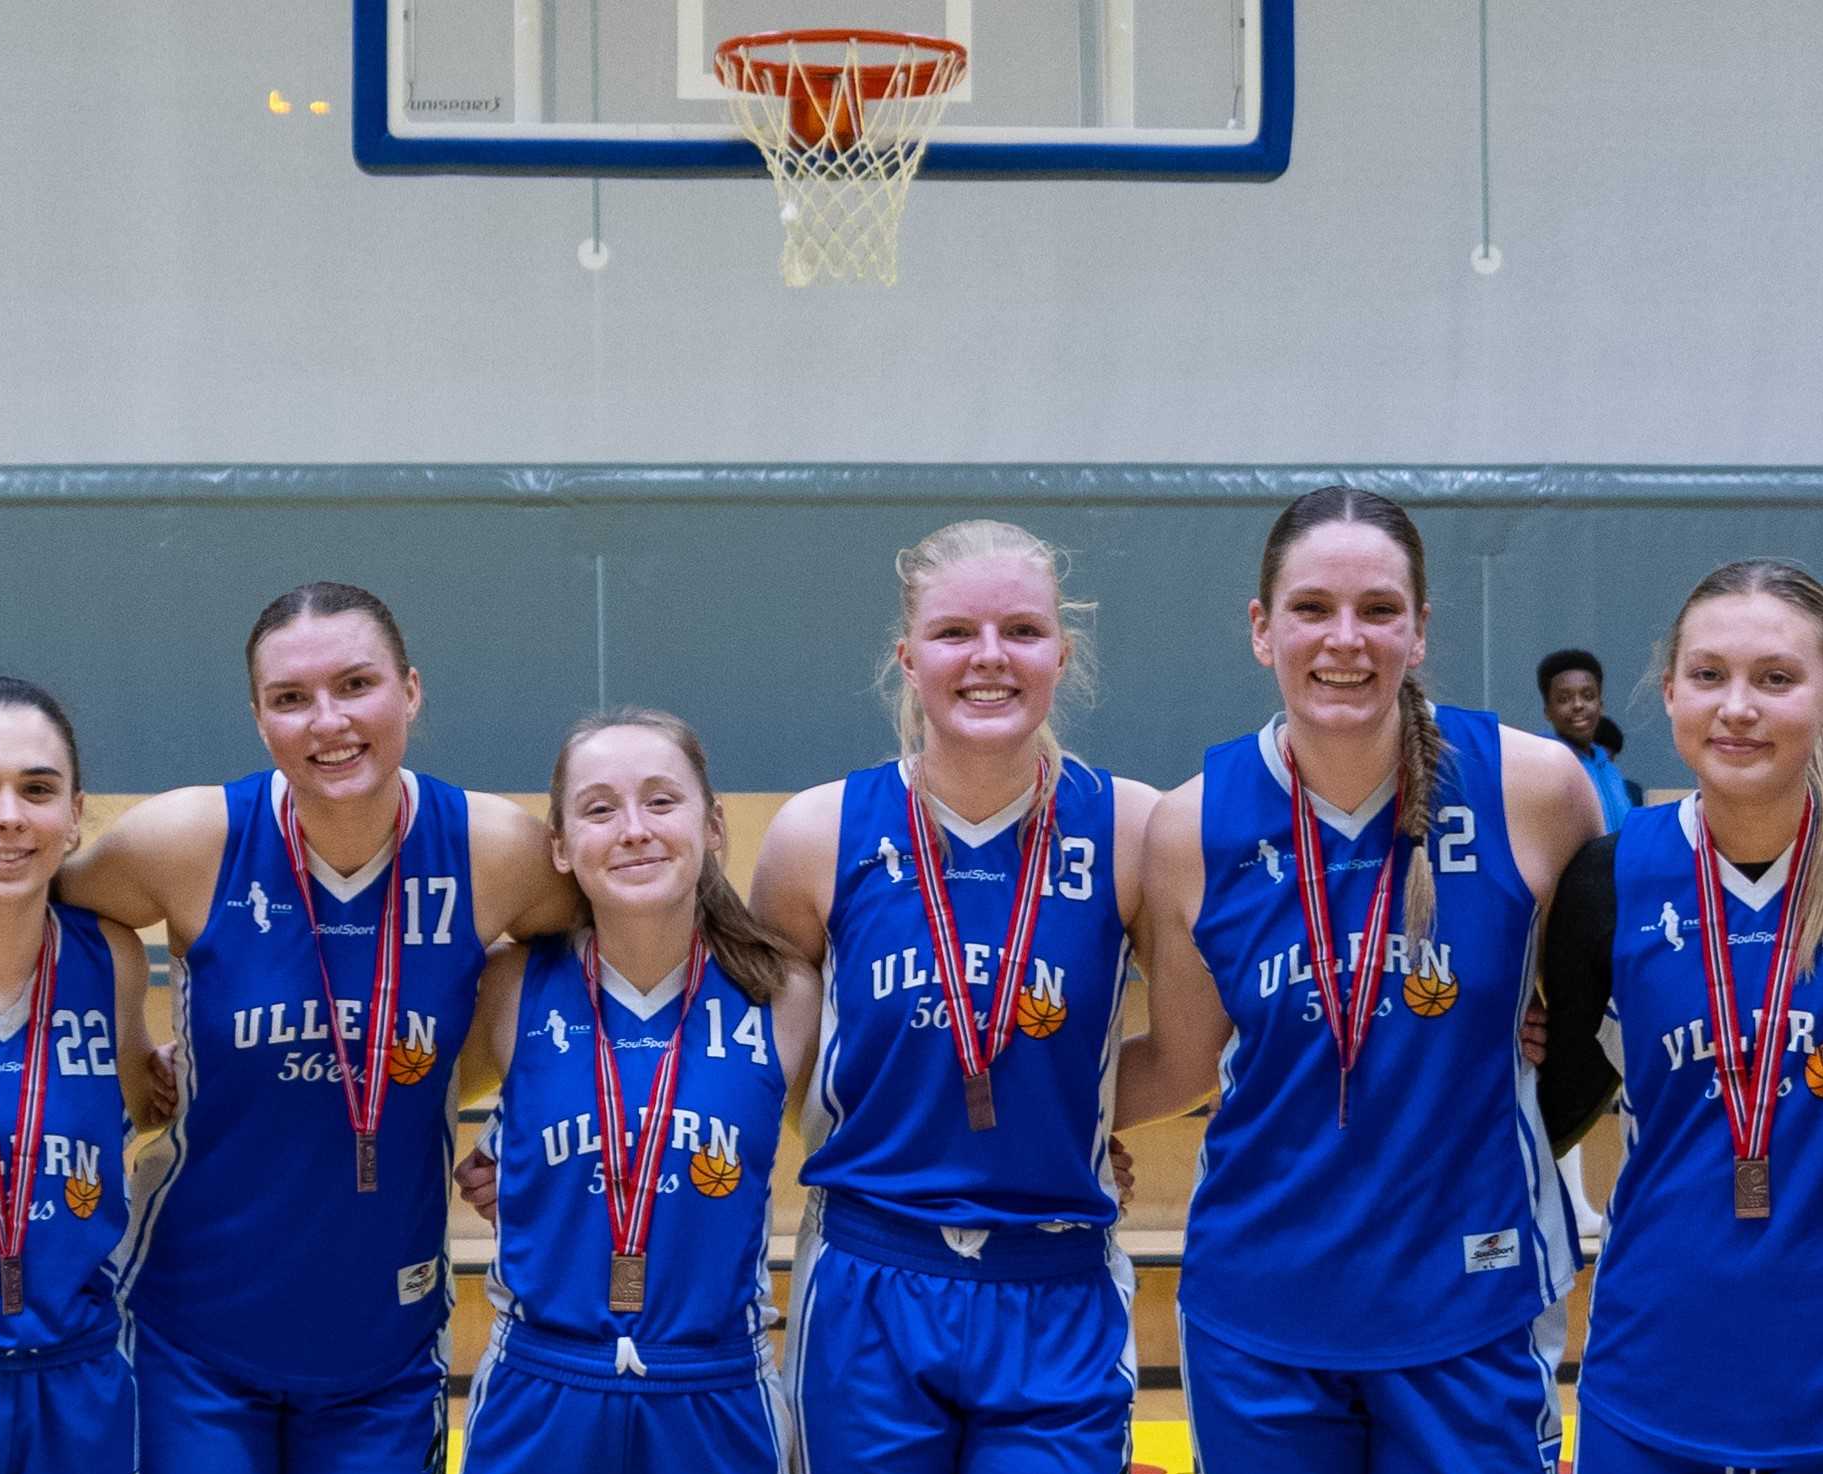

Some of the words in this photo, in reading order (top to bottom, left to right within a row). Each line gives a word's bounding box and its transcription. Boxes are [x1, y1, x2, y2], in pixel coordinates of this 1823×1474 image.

[943, 868, 1008, 882] SoulSport
[1324, 856, 1384, 874] SoulSport
[312, 923, 376, 936] SoulSport
[403, 876, 457, 945] 17
[51, 1009, 118, 1076] 22
[233, 999, 437, 1056] ULLEN
[705, 998, 769, 1066] 14
